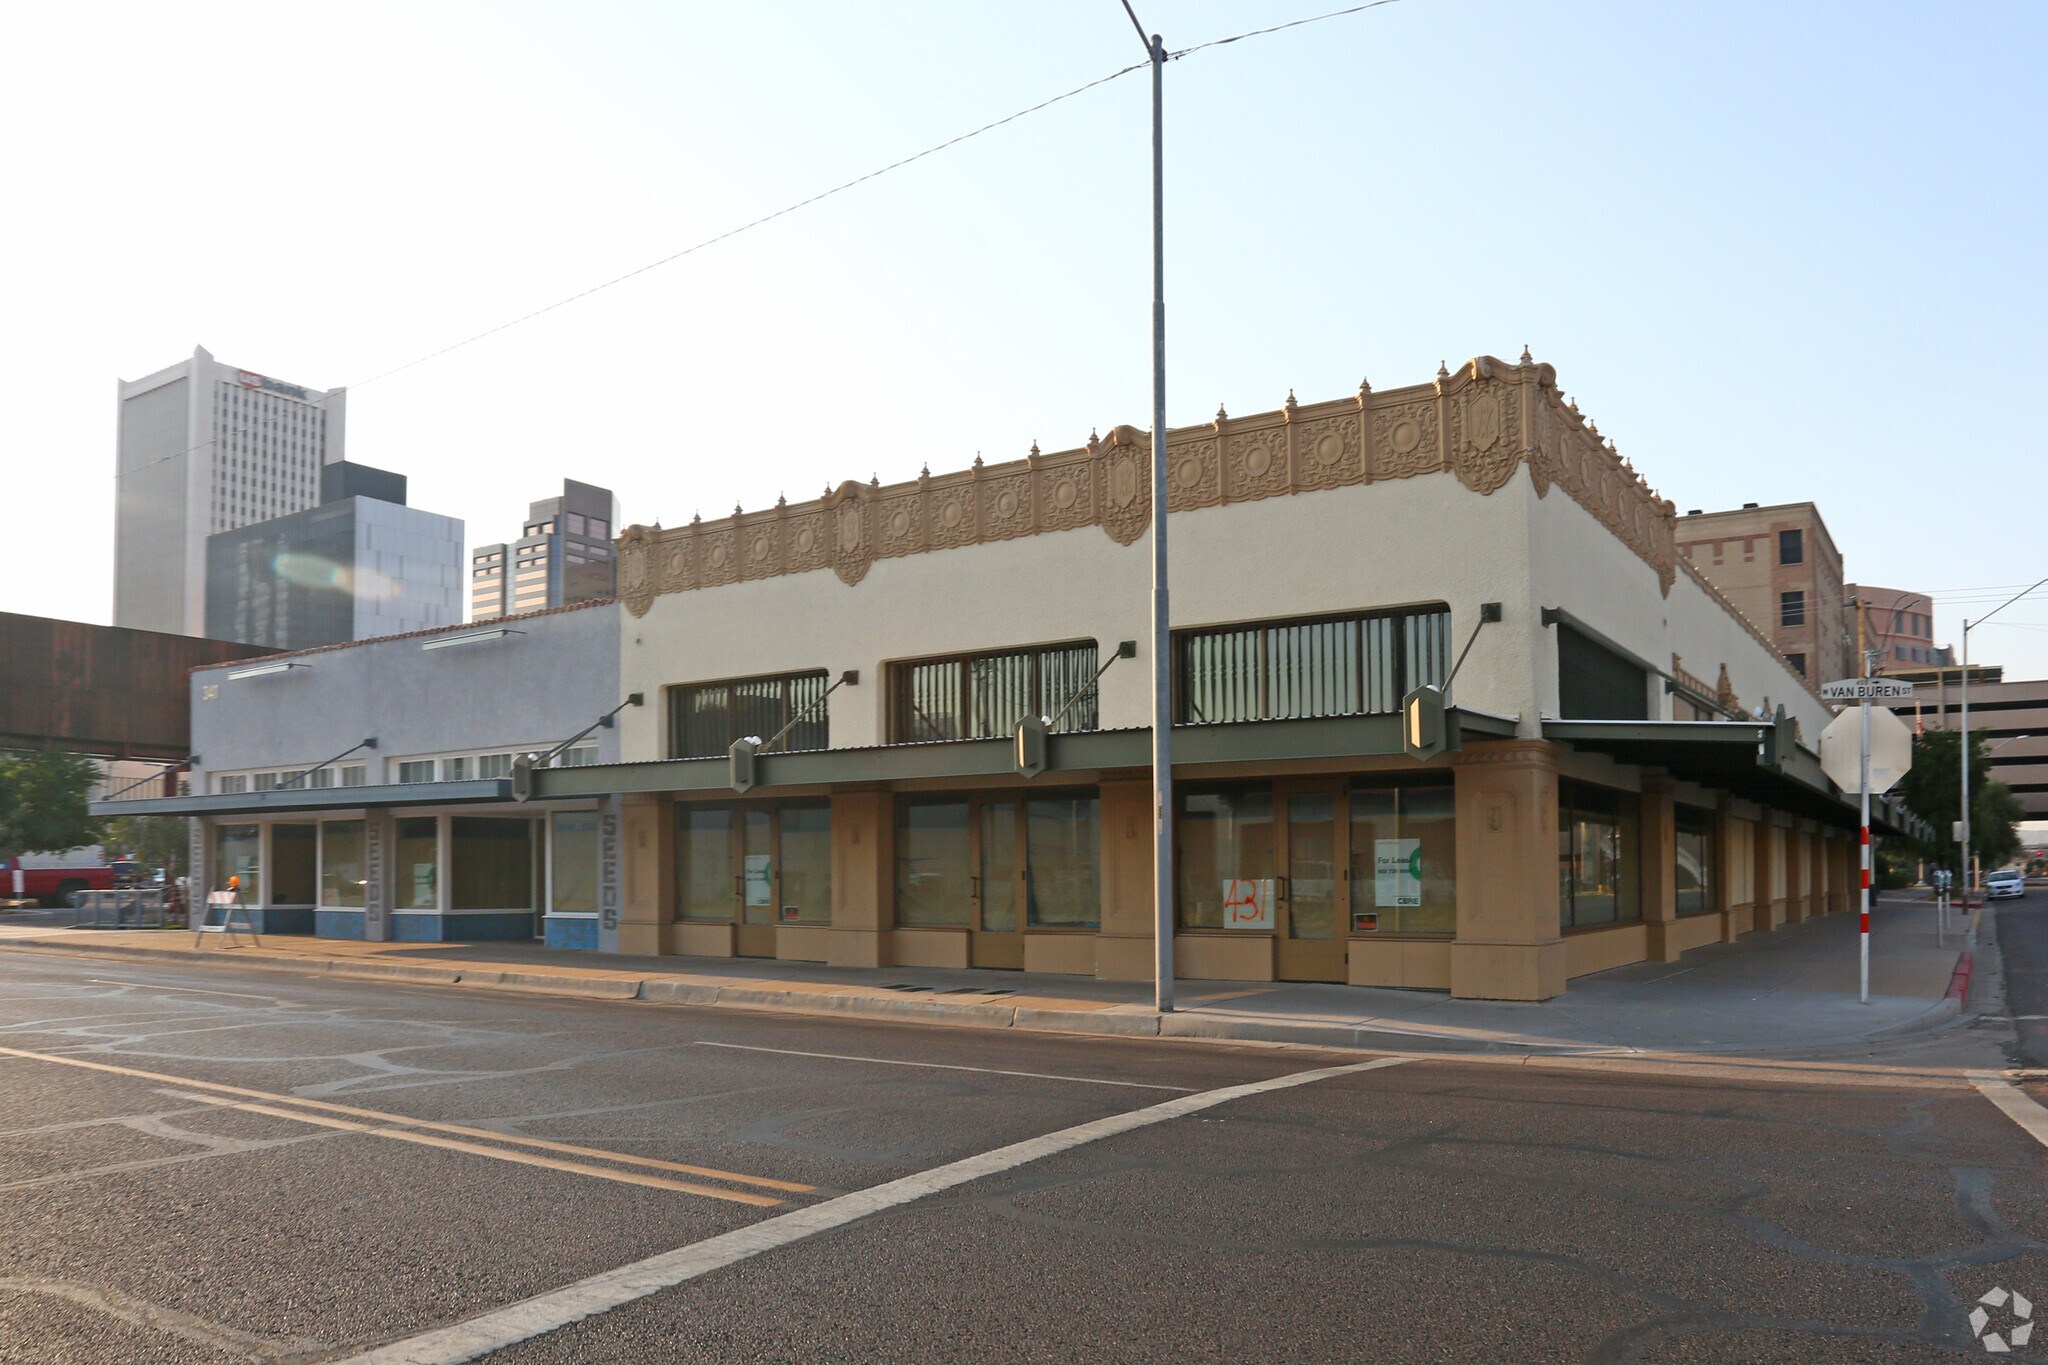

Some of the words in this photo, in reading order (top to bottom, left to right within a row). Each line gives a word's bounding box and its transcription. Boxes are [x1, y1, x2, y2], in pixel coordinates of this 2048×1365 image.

[1831, 687, 1854, 697] VAN
[1858, 686, 1900, 697] BUREN
[602, 814, 617, 930] SEEDS
[1223, 877, 1266, 923] 431
